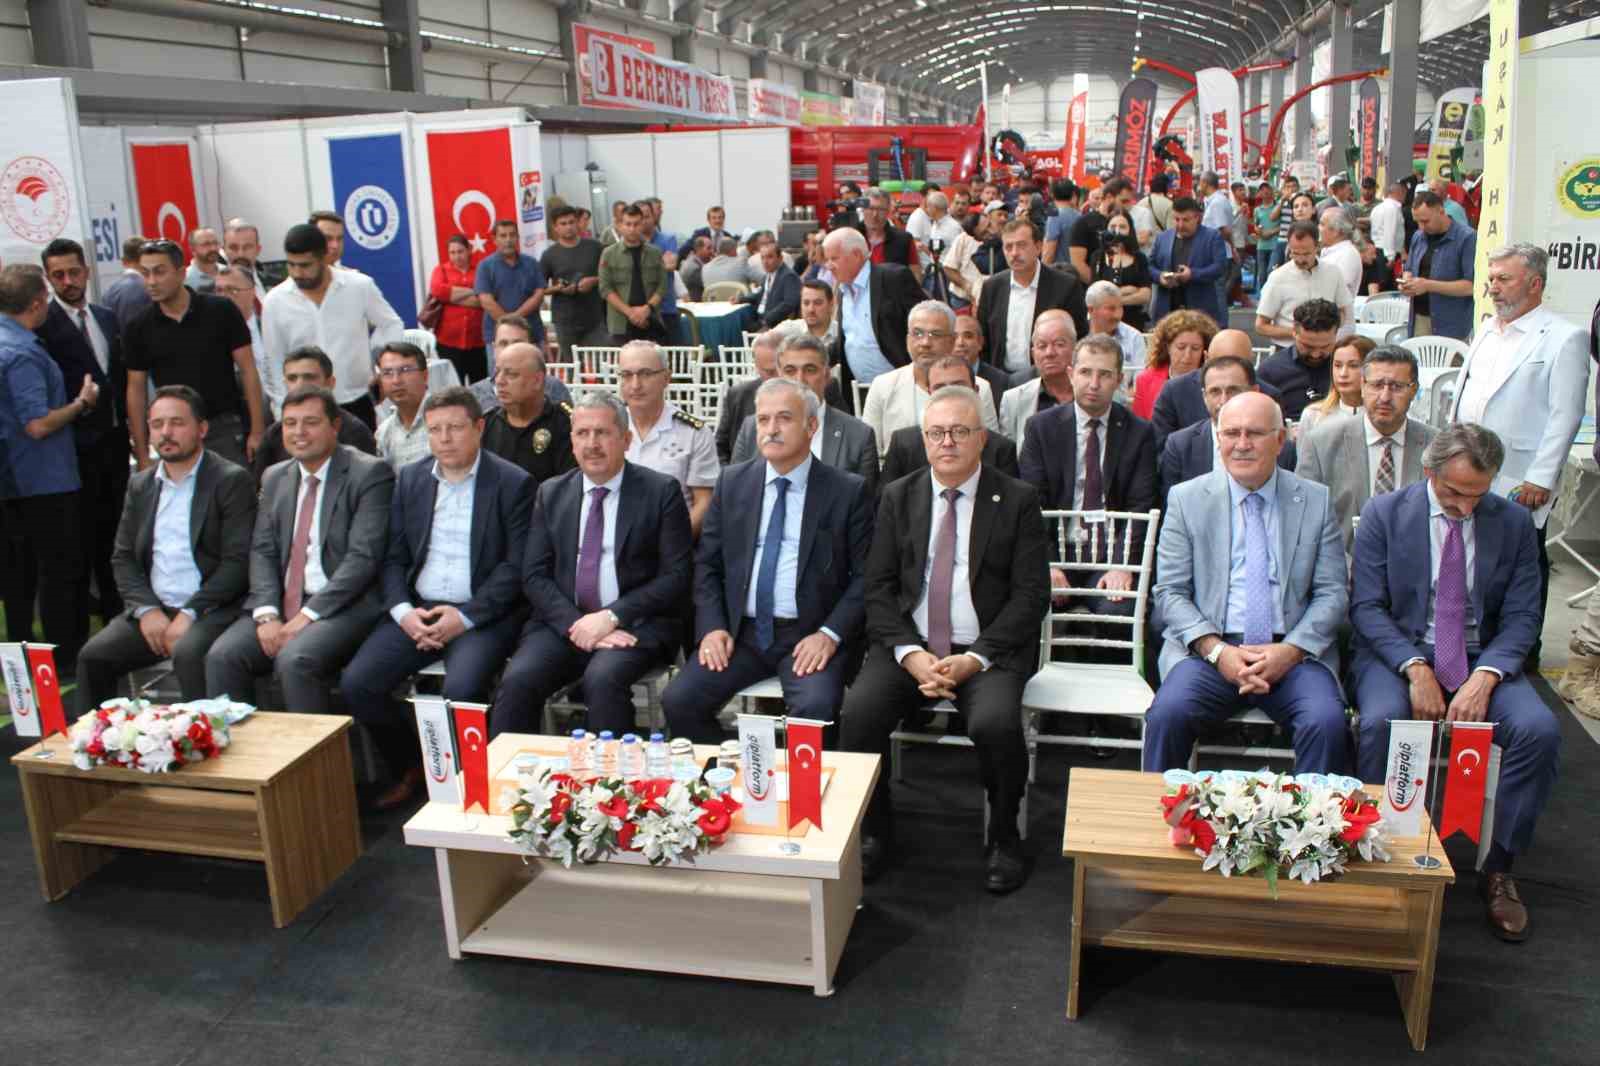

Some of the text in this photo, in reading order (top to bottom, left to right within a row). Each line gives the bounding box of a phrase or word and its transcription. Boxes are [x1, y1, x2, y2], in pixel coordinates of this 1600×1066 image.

[622, 54, 690, 109] BEREKET
[1121, 98, 1147, 186] ARIMÖZ
[1548, 235, 1600, 271] “BİR
